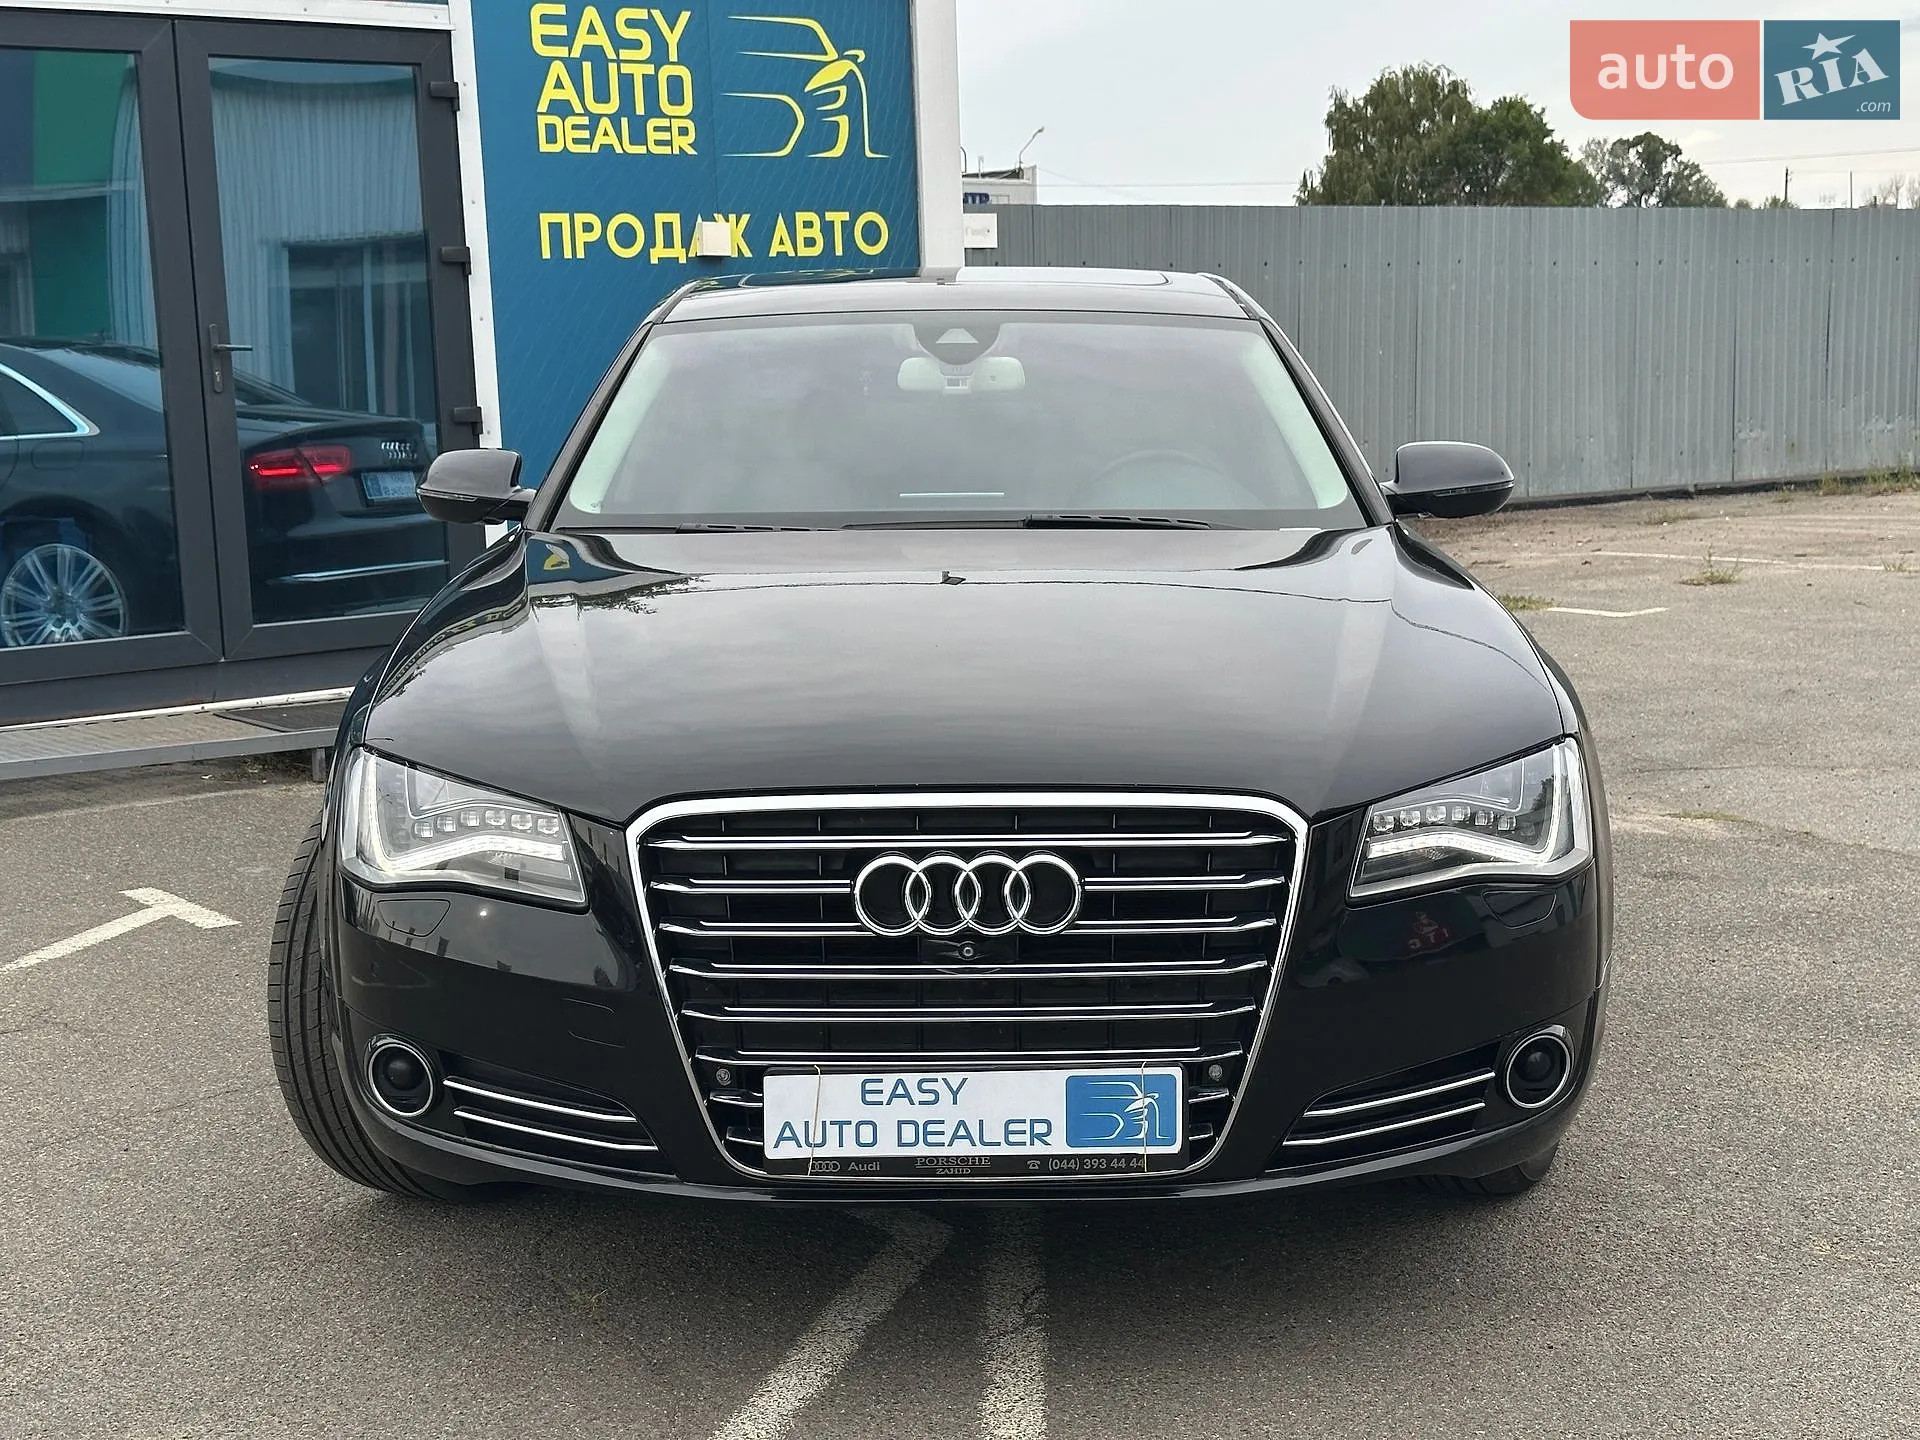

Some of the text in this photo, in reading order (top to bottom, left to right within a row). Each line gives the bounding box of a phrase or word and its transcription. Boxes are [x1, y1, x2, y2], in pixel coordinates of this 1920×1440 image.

[530, 2, 692, 63] EASY
[537, 60, 695, 117] AUTO
[537, 115, 698, 156] DEALER
[769, 211, 889, 257] АВТО
[860, 1077, 969, 1106] EASY
[772, 1118, 1053, 1149] AUTO DEALER
[847, 1161, 881, 1172] Audi
[914, 1156, 991, 1166] PORSCHE
[935, 1167, 971, 1175] ZAHID
[1048, 1158, 1080, 1171] (044)
[1083, 1158, 1107, 1169] 393
[1110, 1158, 1126, 1169] 44
